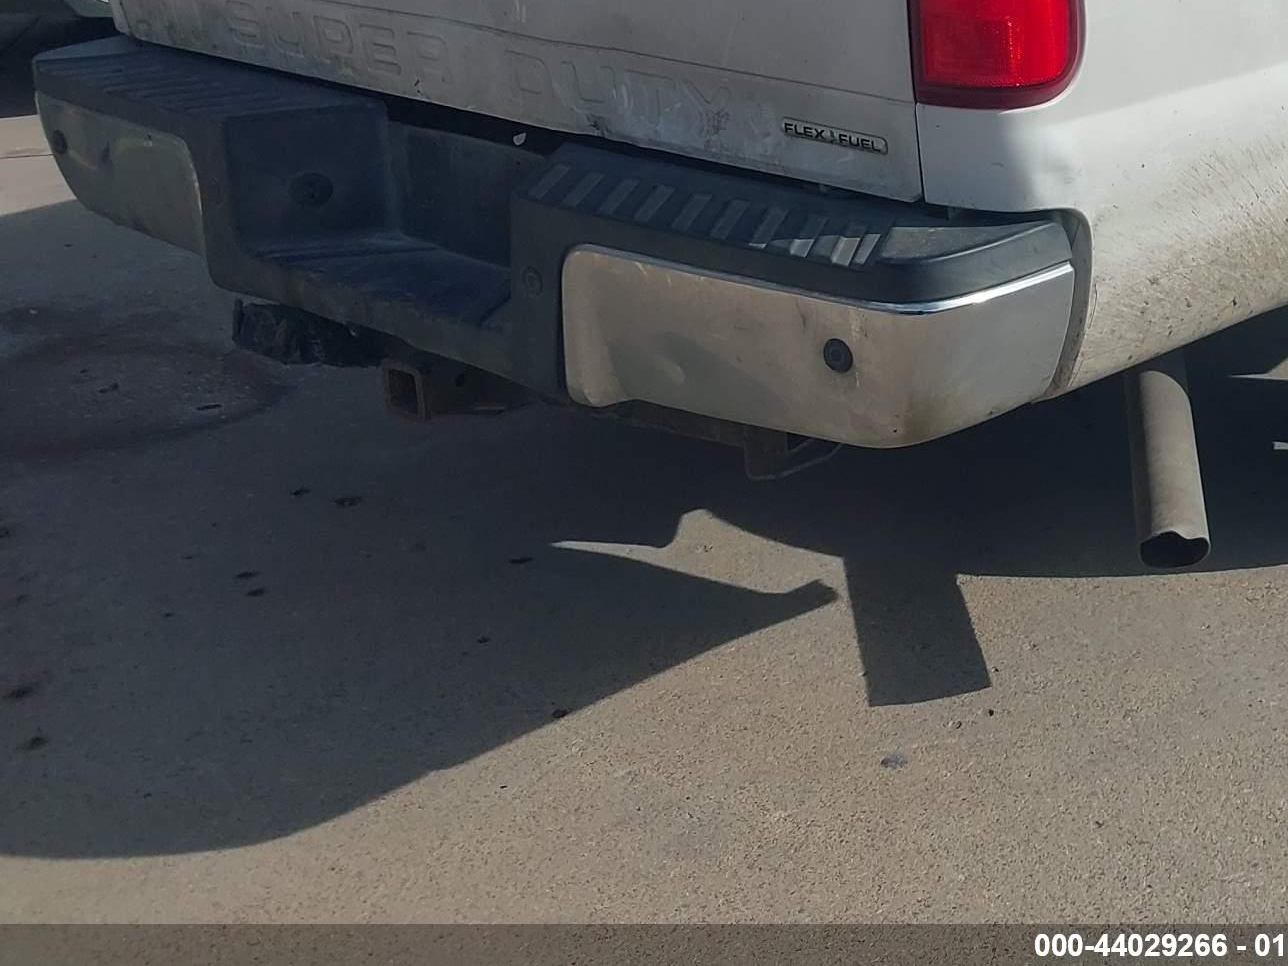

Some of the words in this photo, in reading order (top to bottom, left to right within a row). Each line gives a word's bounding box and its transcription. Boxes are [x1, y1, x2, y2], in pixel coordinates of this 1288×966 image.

[503, 48, 732, 138] DUTY
[783, 122, 825, 140] FLEX
[837, 134, 881, 152] FUEL
